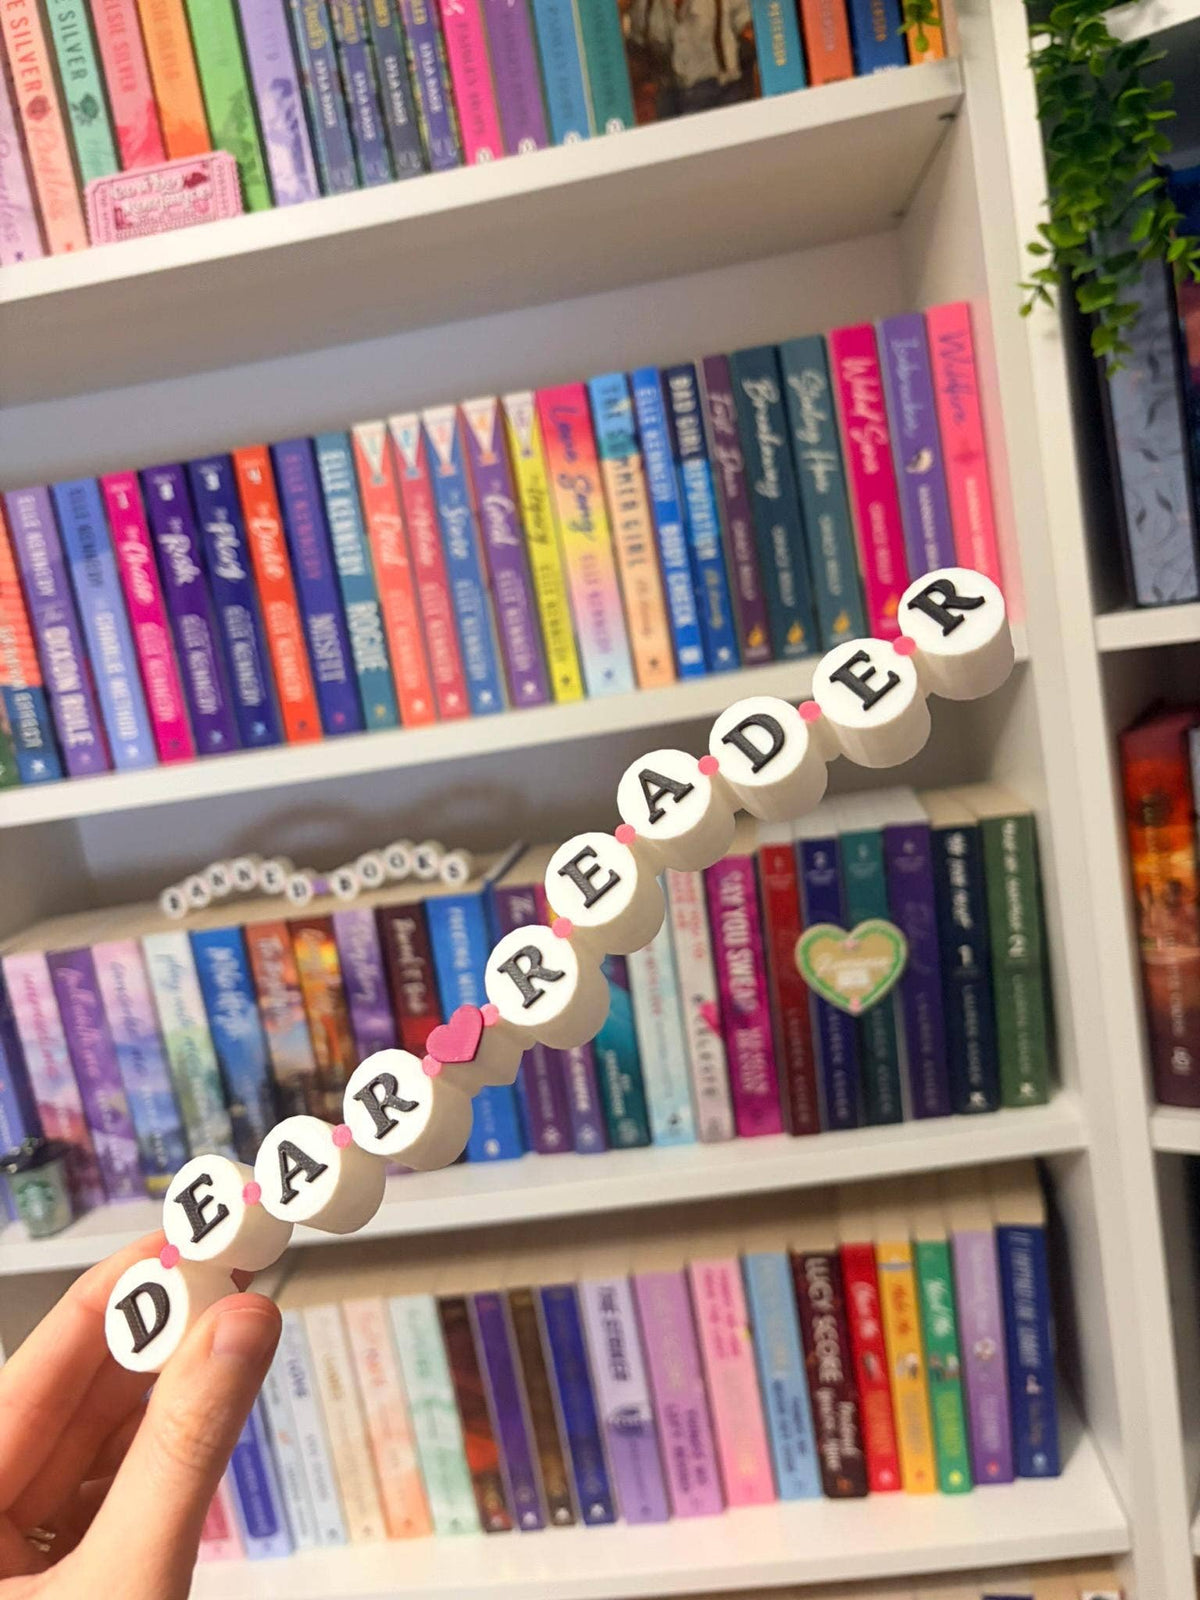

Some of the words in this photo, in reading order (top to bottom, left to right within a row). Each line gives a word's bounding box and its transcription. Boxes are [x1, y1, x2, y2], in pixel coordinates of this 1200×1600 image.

[10, 19, 43, 92] SILVER
[58, 12, 87, 81] SILVER
[112, 42, 134, 93] SILVER
[418, 42, 434, 77] LYLA
[637, 387, 663, 423] ELLE
[668, 376, 695, 414] BAD
[674, 415, 703, 457] GIRL
[741, 377, 783, 500] Breakaway
[320, 450, 353, 493] ELLE
[645, 430, 676, 503] KENNEDY
[16, 496, 40, 528] ELLE
[328, 498, 365, 576] KENNEDY
[481, 493, 516, 549] Goal
[683, 459, 720, 561] REPUTATION
[22, 531, 56, 598] KENNEDY
[158, 533, 201, 588] Risk
[204, 521, 245, 582] Play
[250, 516, 283, 581] Date
[372, 513, 407, 567] Deal
[621, 521, 645, 570] GIRL
[658, 522, 686, 569] BODY
[668, 572, 695, 629] CHECK
[347, 602, 388, 674] ROGUE
[45, 626, 80, 692] DIXON
[63, 694, 92, 747] RULE
[720, 871, 746, 907] SAY
[722, 908, 751, 945] YOU
[1008, 933, 1026, 958] 2
[115, 1072, 419, 1353] DEAR
[497, 578, 985, 1009] READER
[725, 948, 755, 1012] SWEAR
[804, 1257, 836, 1312] LUCY
[812, 1314, 843, 1383] SCORE
